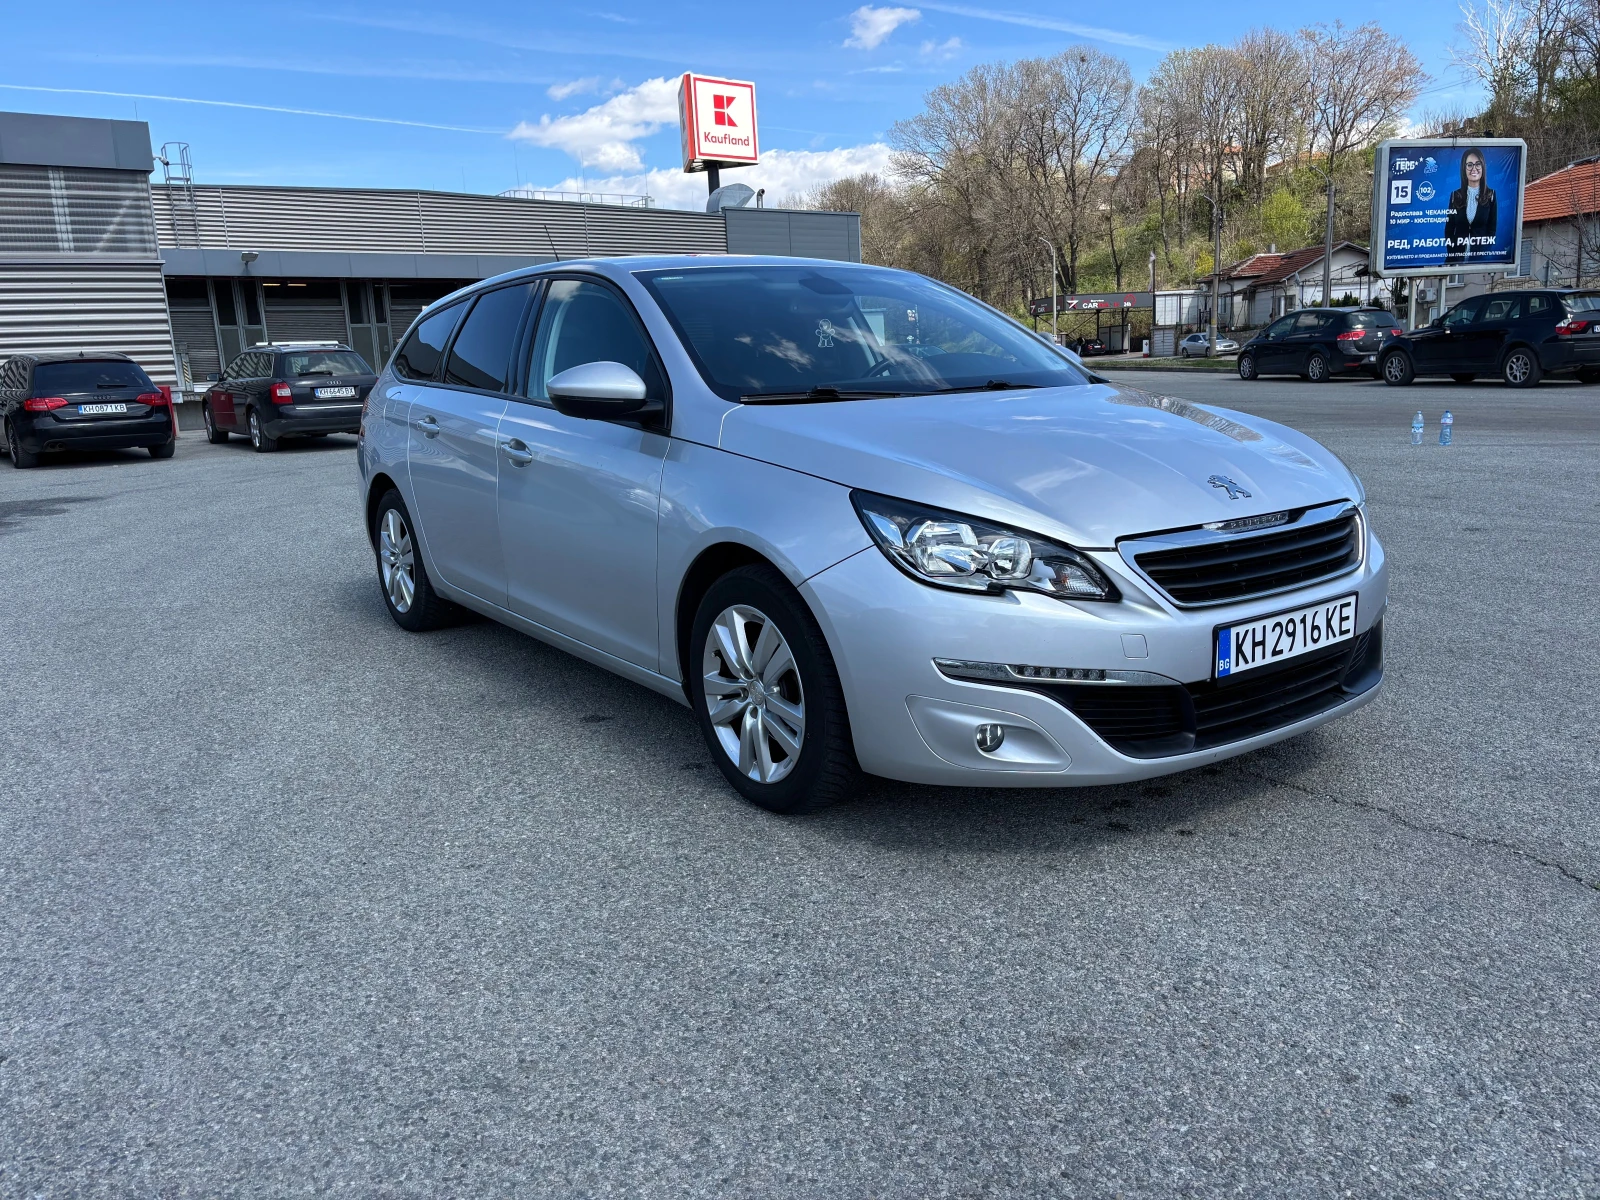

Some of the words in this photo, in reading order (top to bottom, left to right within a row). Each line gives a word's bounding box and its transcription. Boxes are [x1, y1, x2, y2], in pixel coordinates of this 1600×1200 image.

[704, 131, 750, 146] Kaufland
[1394, 185, 1408, 198] 15
[1425, 208, 1458, 216] ЧЕКАНСКА
[1387, 239, 1411, 250] РЕД,
[1413, 237, 1455, 248] РАБОТА,
[1457, 236, 1496, 246] РАСТЕЖ
[1235, 601, 1352, 668] KH2916KE
[1219, 658, 1230, 671] BG
